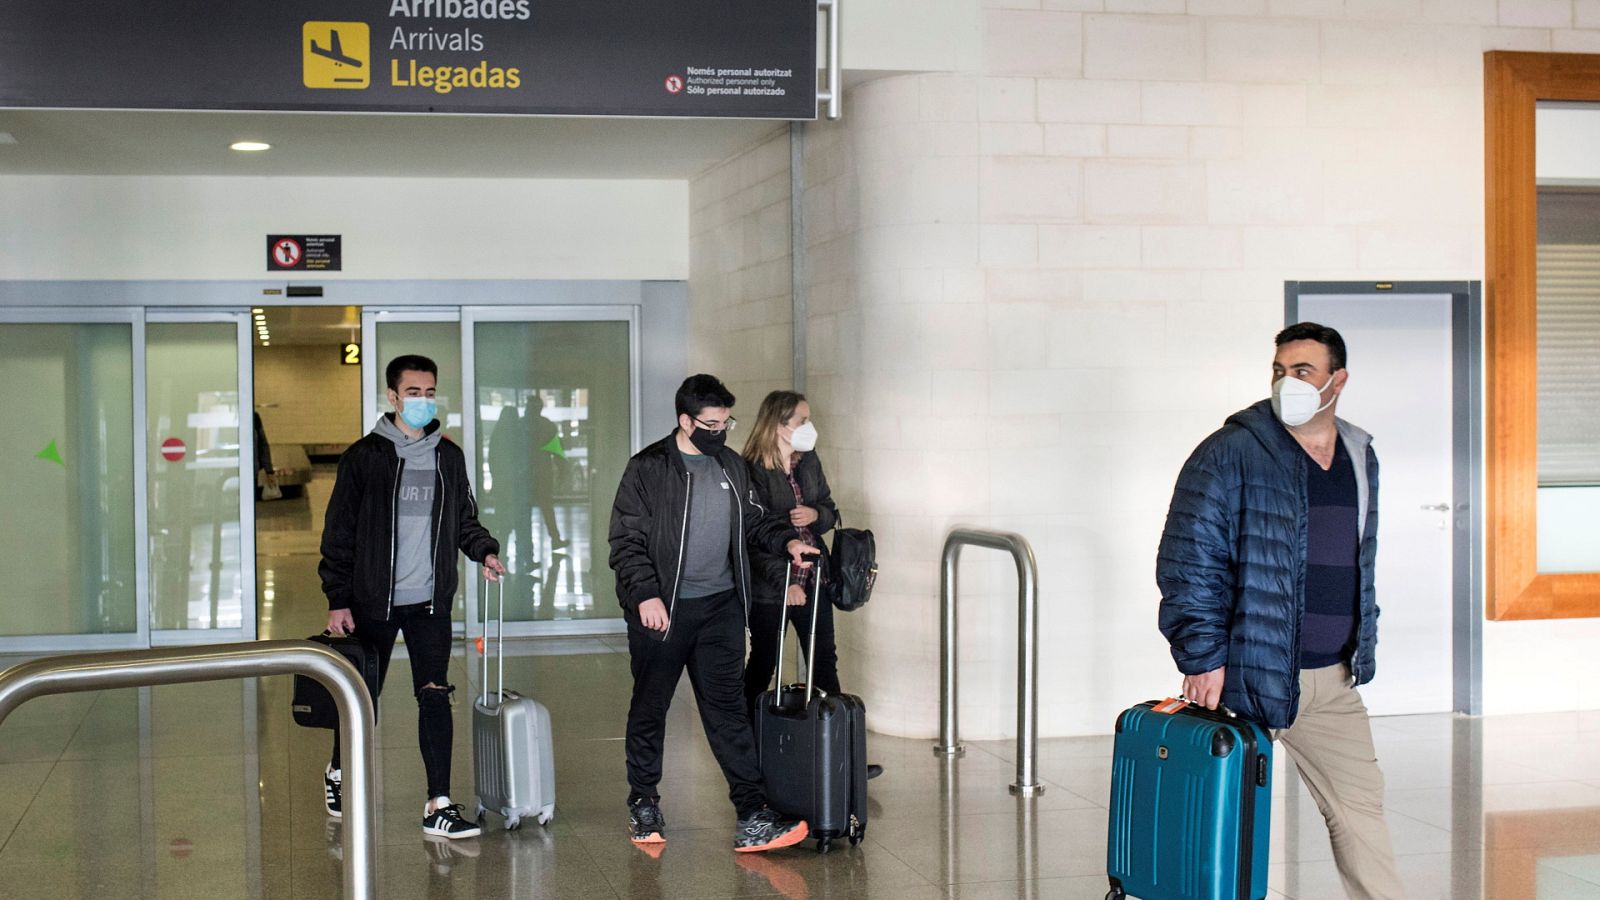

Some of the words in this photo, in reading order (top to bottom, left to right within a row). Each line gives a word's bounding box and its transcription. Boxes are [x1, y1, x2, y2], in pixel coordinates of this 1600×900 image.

[389, 0, 531, 20] Arribades
[389, 26, 484, 52] Arrivals
[391, 59, 521, 94] Llegadas
[687, 66, 715, 76] Només
[717, 68, 752, 78] personal
[754, 68, 792, 78] autoritzat
[687, 77, 724, 85] Authorized
[726, 78, 759, 86] personnel
[760, 79, 776, 87] only
[687, 85, 705, 95] Sólo
[707, 86, 741, 96] personal
[743, 87, 786, 96] autorizado
[345, 343, 360, 364] 2
[399, 486, 419, 501] UR
